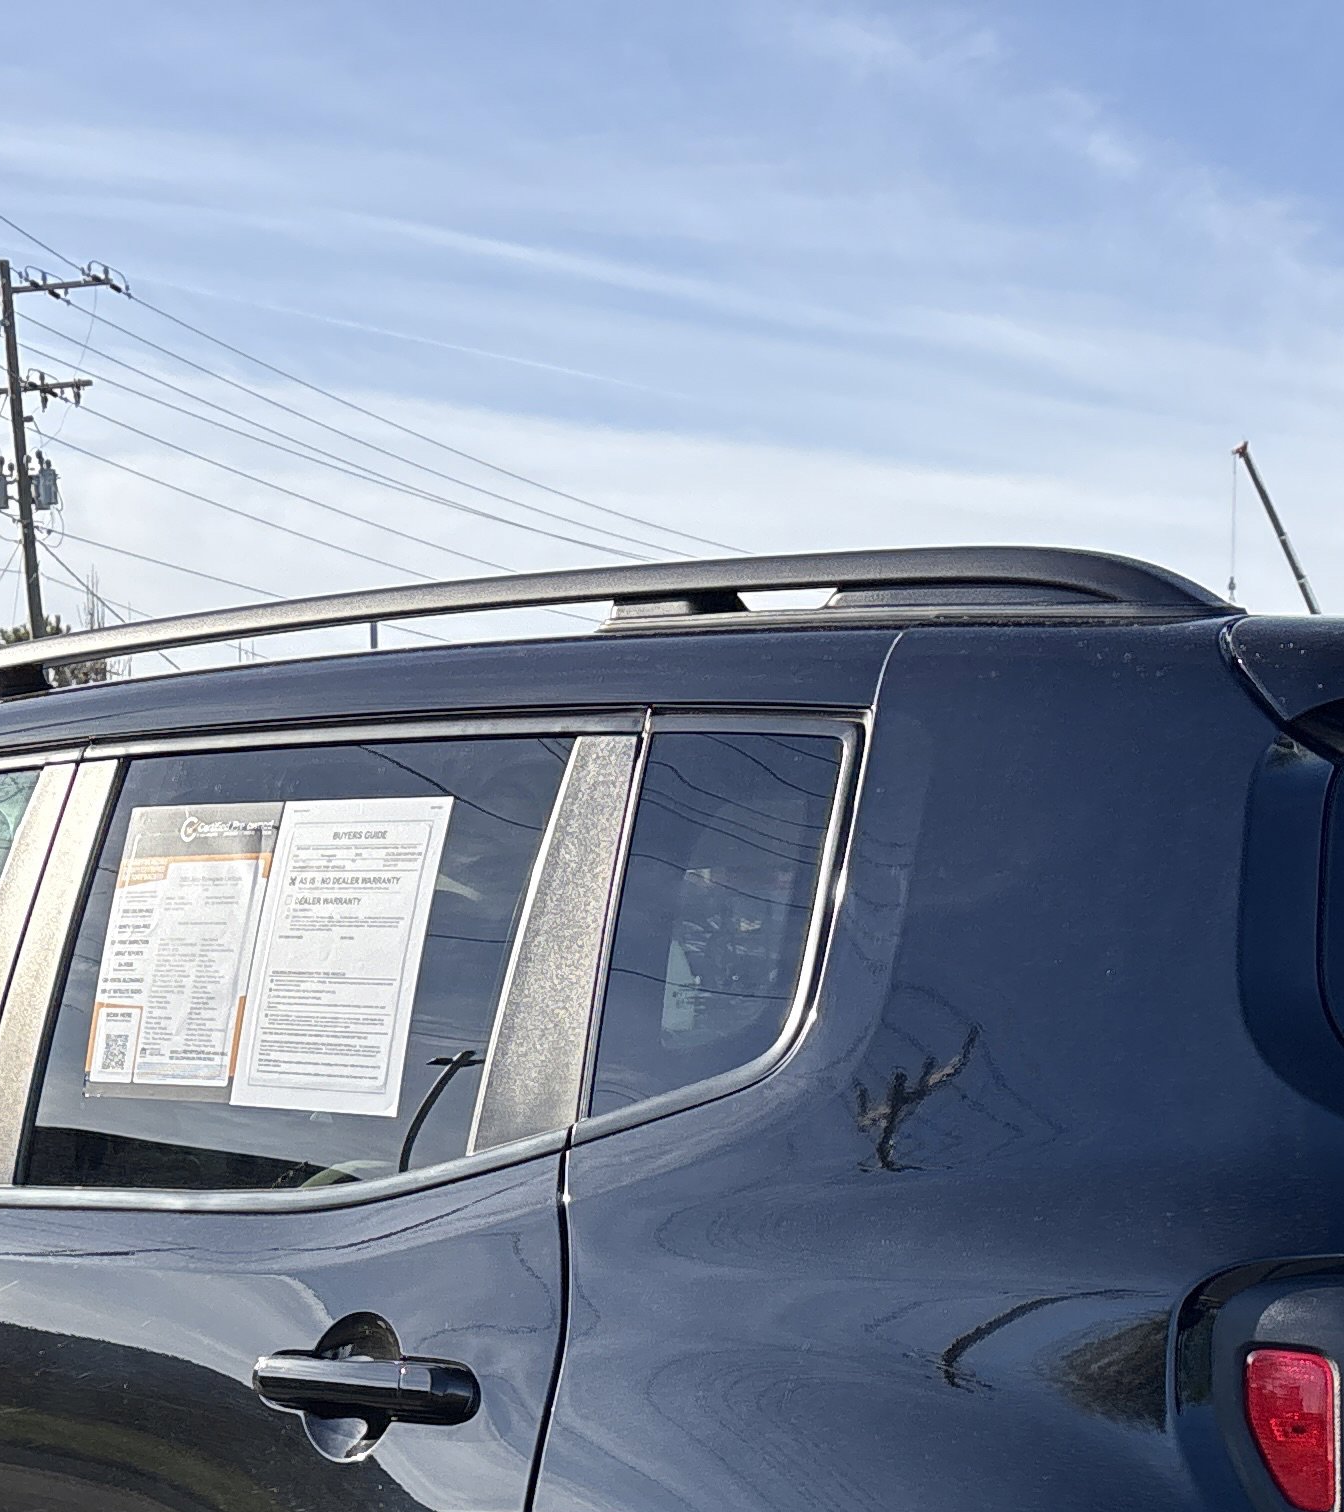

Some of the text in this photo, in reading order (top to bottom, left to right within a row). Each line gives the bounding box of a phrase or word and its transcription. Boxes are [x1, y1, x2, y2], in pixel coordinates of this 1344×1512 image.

[332, 830, 388, 840] BUYERS GUIDE
[321, 877, 332, 885] NO
[332, 877, 360, 885] DEALER
[361, 876, 402, 885] WARRANTY
[294, 896, 362, 906] DEALER WARRANTY
